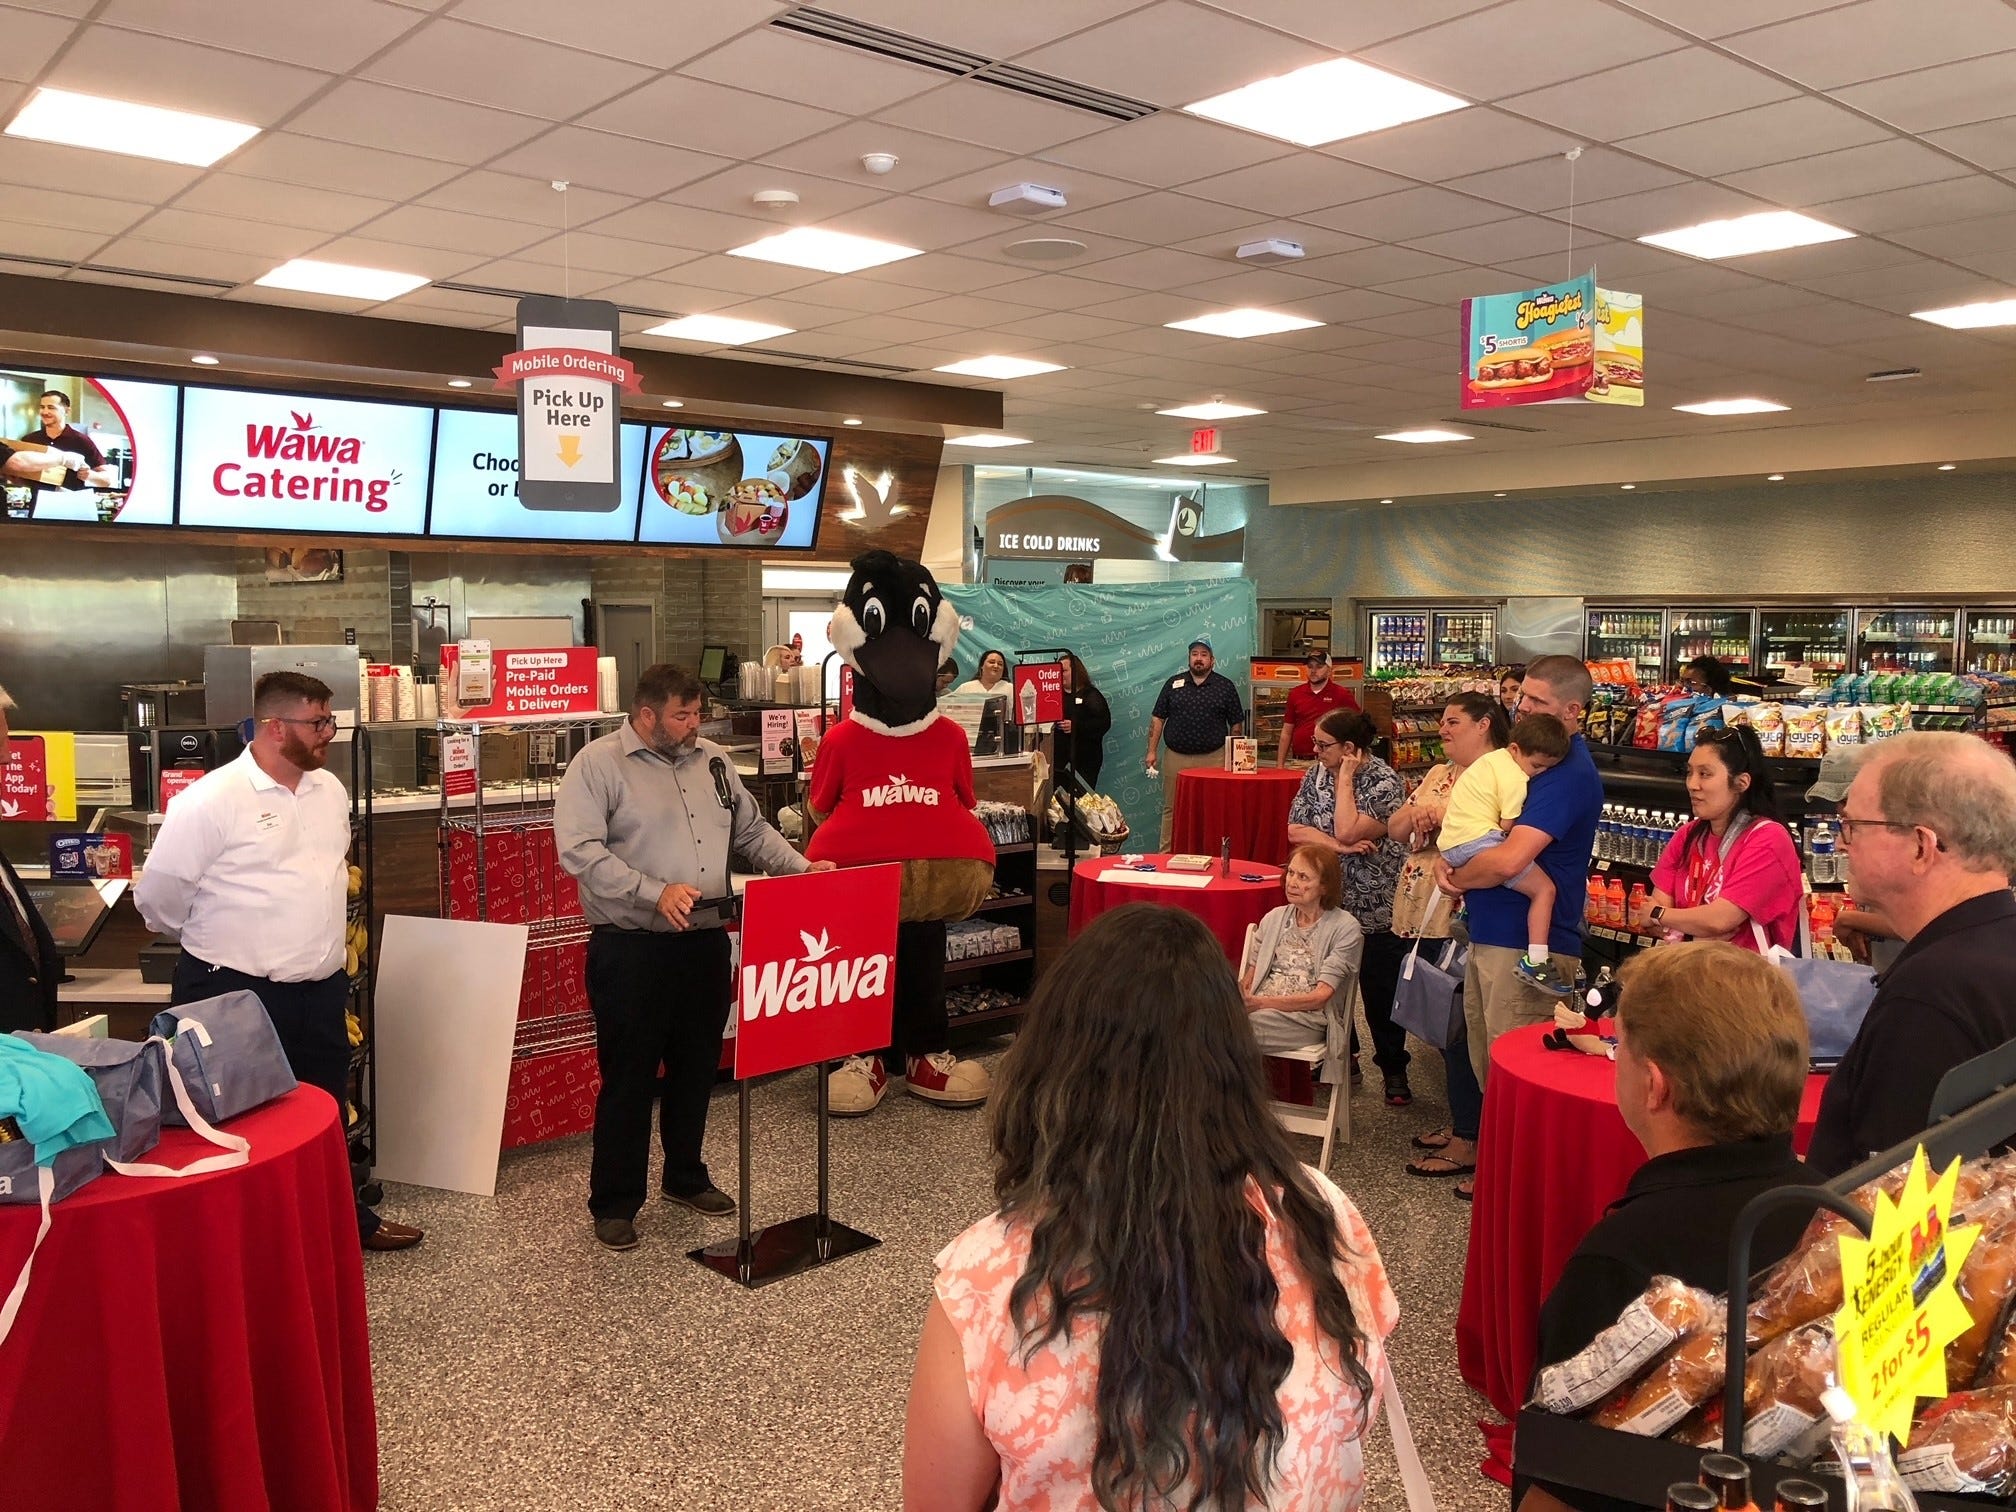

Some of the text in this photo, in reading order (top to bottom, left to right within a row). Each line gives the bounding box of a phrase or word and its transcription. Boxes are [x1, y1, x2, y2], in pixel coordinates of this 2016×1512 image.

[1517, 290, 1582, 329] Hoagiefest
[1481, 335, 1527, 354] $5 SHORTIS
[512, 354, 625, 382] Mobile Ordering
[533, 389, 604, 412] Pick Up
[547, 409, 591, 427] Here
[247, 424, 361, 464] Wawa
[1193, 430, 1216, 453] EXIT
[472, 452, 519, 472] Choo
[213, 463, 391, 513] Catering
[488, 483, 508, 496] or
[999, 533, 1101, 552] ICE COLD DRINKS
[511, 656, 563, 667] Pick Up Here
[506, 669, 556, 682] Pre-Paid
[1038, 669, 1060, 681] Order
[506, 684, 588, 697] Mobile Orders
[1042, 681, 1060, 692] Here
[506, 699, 570, 712] & Delivery
[767, 721, 789, 729] Hiring!
[768, 713, 787, 721] We're
[5, 773, 24, 784] App
[5, 784, 38, 795] Today!
[862, 783, 939, 807] Wawa
[743, 953, 888, 1022] Wawa
[1860, 1250, 1904, 1316] ENERGY
[1862, 1284, 1908, 1344] REGULAR
[1905, 1310, 1931, 1359] $5
